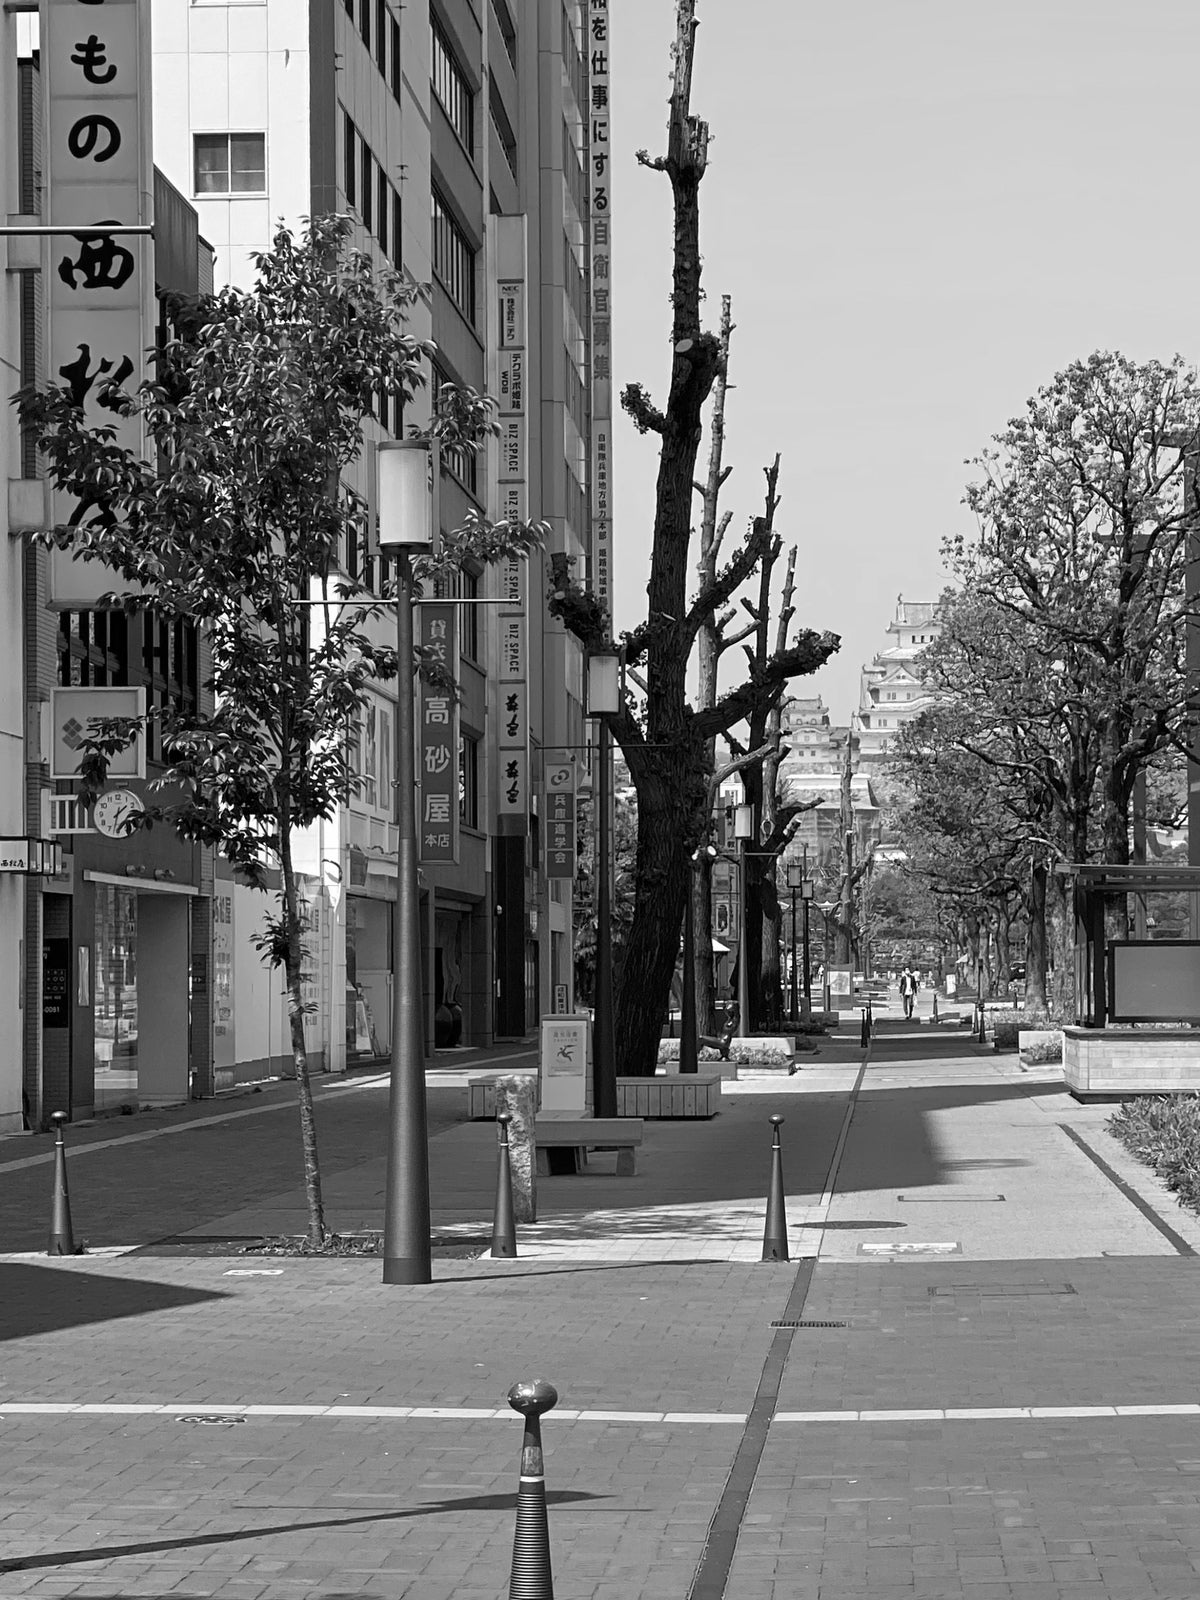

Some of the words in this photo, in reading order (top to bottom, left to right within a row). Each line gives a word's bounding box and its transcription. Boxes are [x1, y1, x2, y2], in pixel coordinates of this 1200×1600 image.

[501, 370, 509, 394] WDB
[508, 424, 519, 439] BIZ
[508, 442, 519, 473] SPACE
[508, 491, 519, 505] BIZ
[508, 558, 519, 574] BIZ
[508, 624, 519, 639] BIZ
[508, 641, 519, 672] SPACE
[424, 696, 450, 822] 高砂屋
[425, 834, 450, 847] 本店
